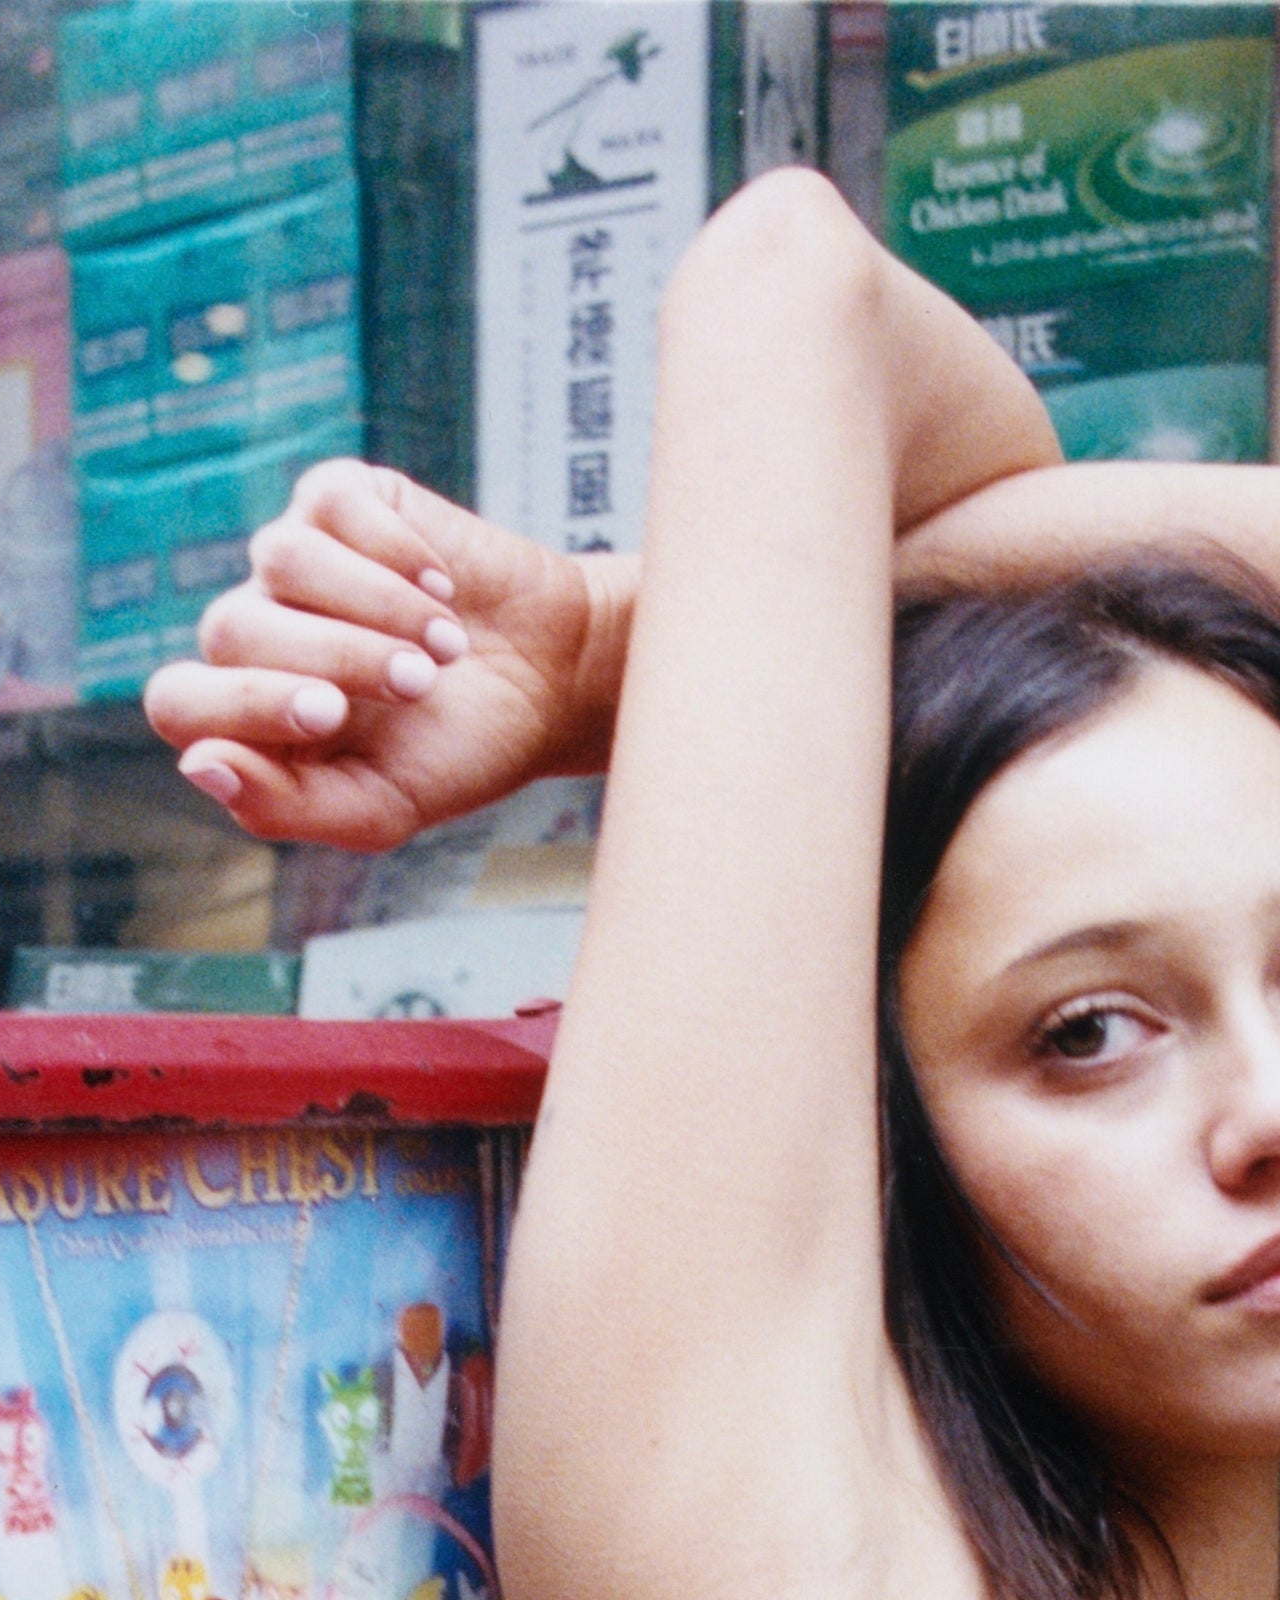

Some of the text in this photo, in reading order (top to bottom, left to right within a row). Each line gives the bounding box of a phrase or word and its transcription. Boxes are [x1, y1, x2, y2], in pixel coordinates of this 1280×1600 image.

[933, 142, 1048, 192] Essence of
[910, 178, 1069, 234] Chicken Drink
[183, 1127, 380, 1208] CHEST
